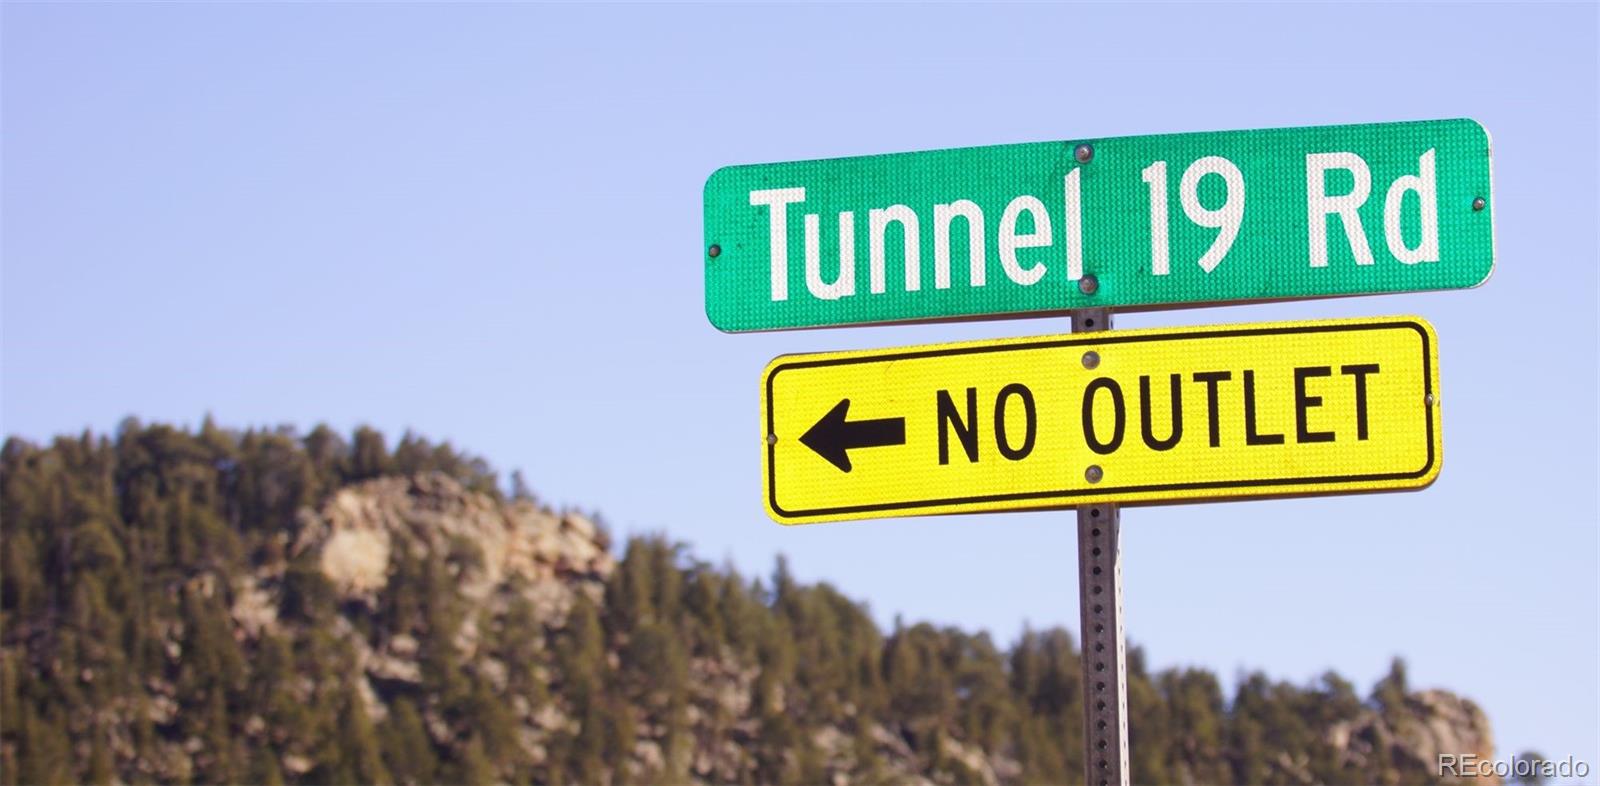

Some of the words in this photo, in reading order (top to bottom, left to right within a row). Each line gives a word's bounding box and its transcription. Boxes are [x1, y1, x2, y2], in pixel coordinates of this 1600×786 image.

[750, 167, 1084, 302] Tunnel
[1141, 155, 1246, 276] 19
[1305, 147, 1440, 268] Rd
[936, 383, 1037, 465] NO
[1082, 363, 1380, 455] OUTLET
